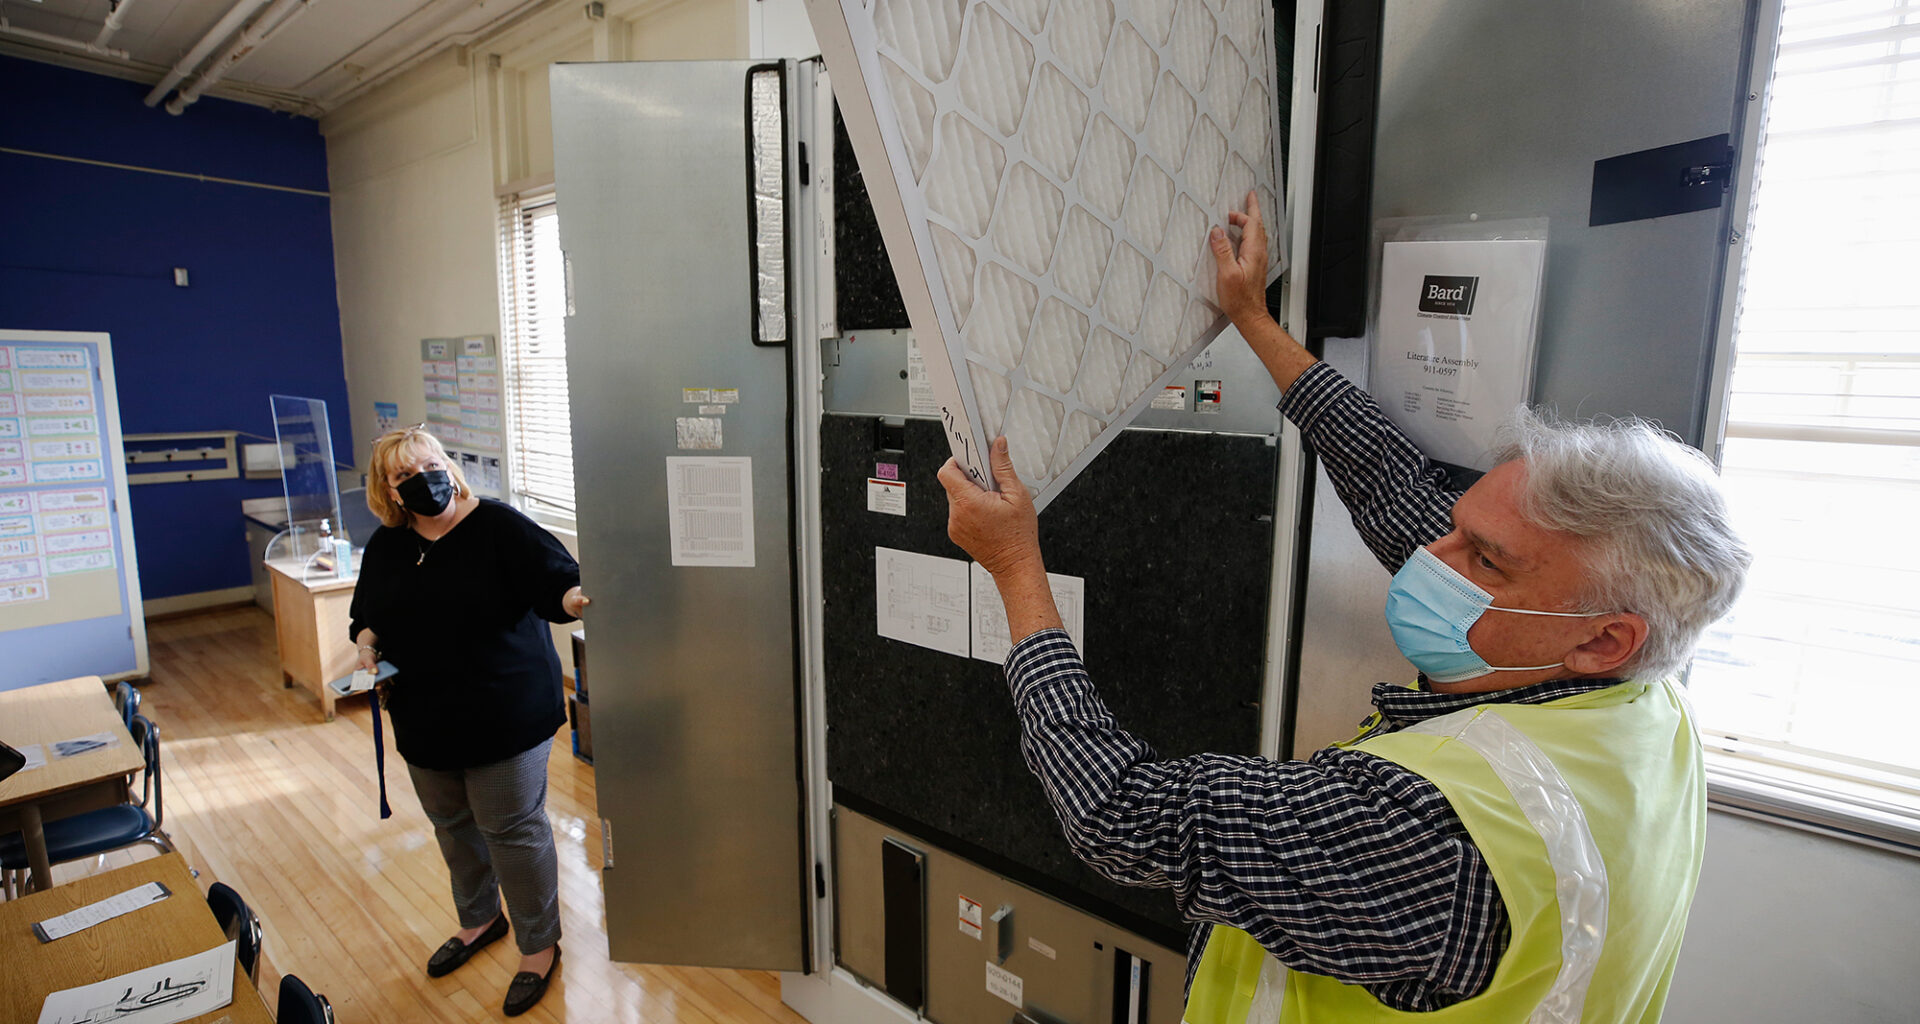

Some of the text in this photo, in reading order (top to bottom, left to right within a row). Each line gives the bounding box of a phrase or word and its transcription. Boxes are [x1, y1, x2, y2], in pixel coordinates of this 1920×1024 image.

[1427, 284, 1464, 301] Bard
[1407, 351, 1480, 370] Literare Assembly
[1423, 364, 1457, 376] 911-0597
